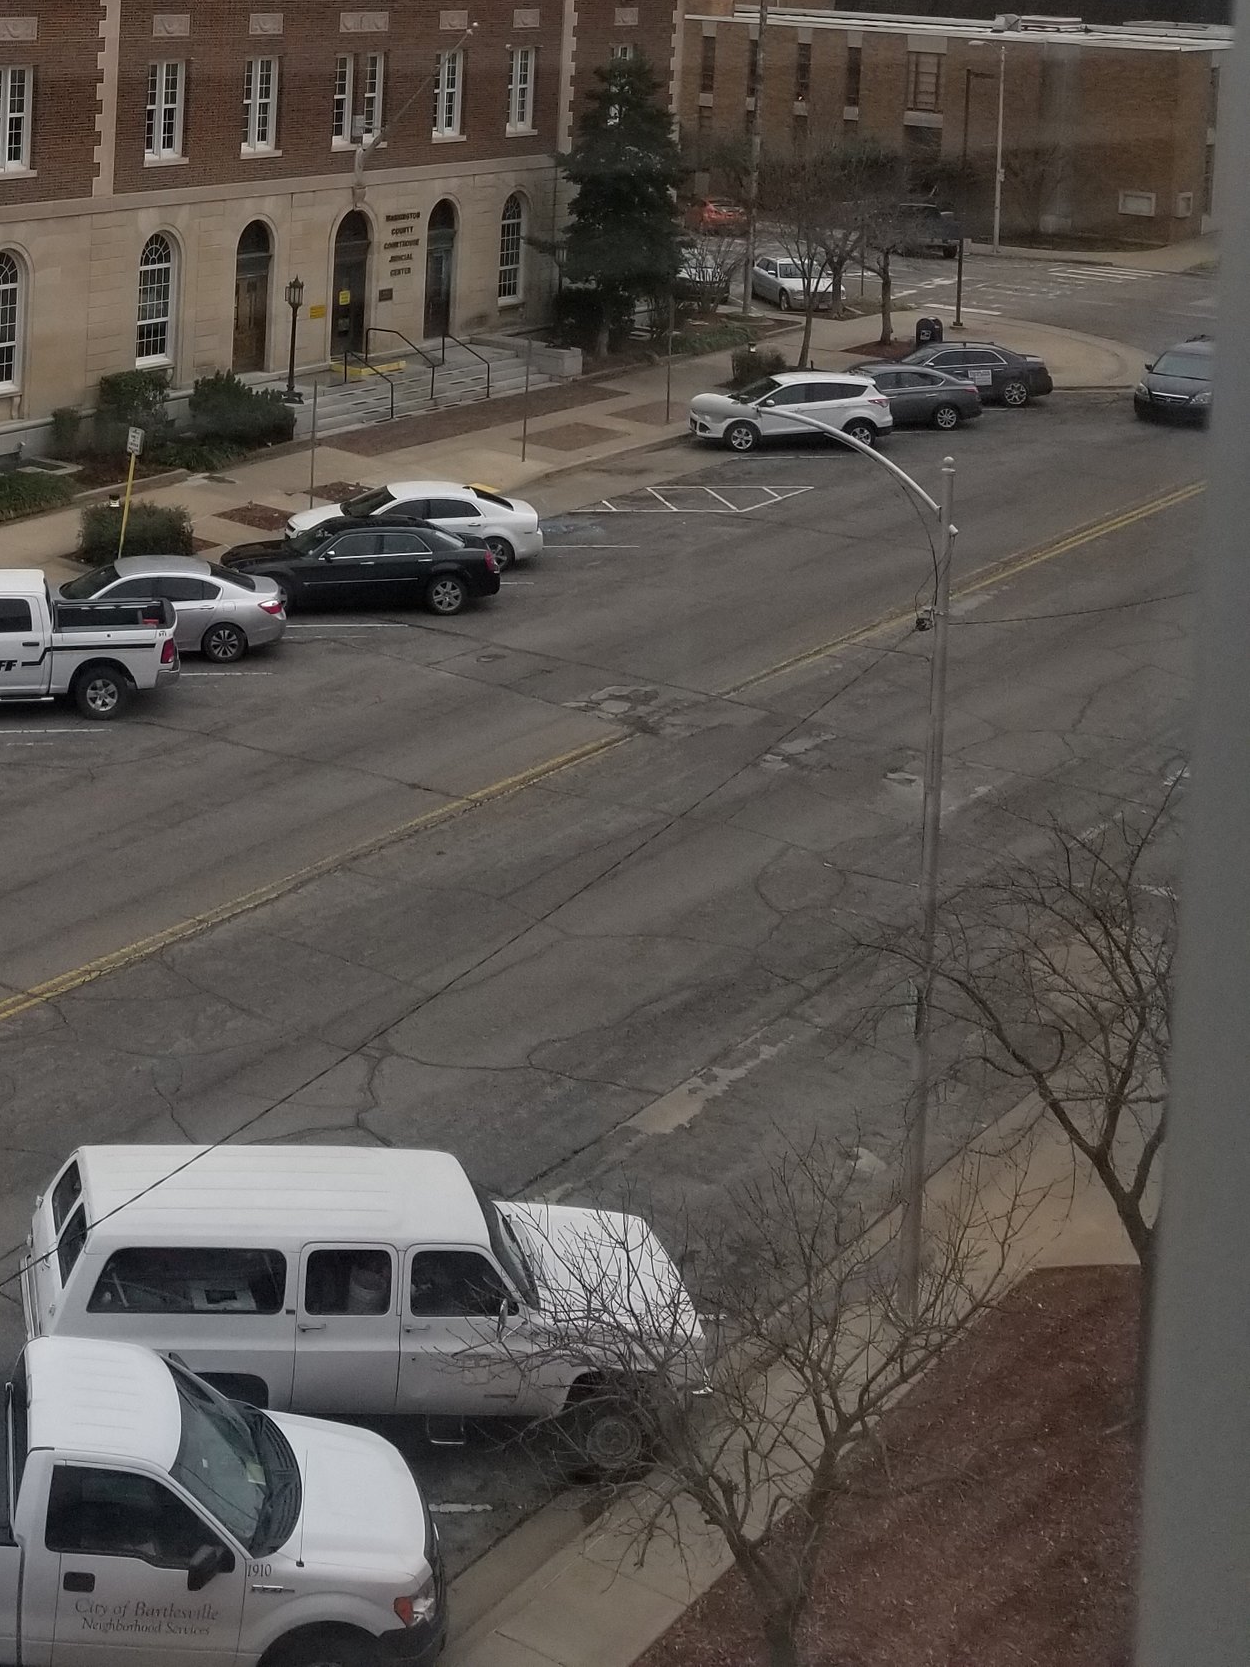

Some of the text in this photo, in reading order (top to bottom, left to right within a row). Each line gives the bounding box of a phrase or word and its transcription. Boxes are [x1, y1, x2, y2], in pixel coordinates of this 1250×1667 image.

[247, 1564, 272, 1577] 1910
[75, 1597, 219, 1621] City of Bartlesville
[82, 1617, 211, 1636] Neighborhood Services
